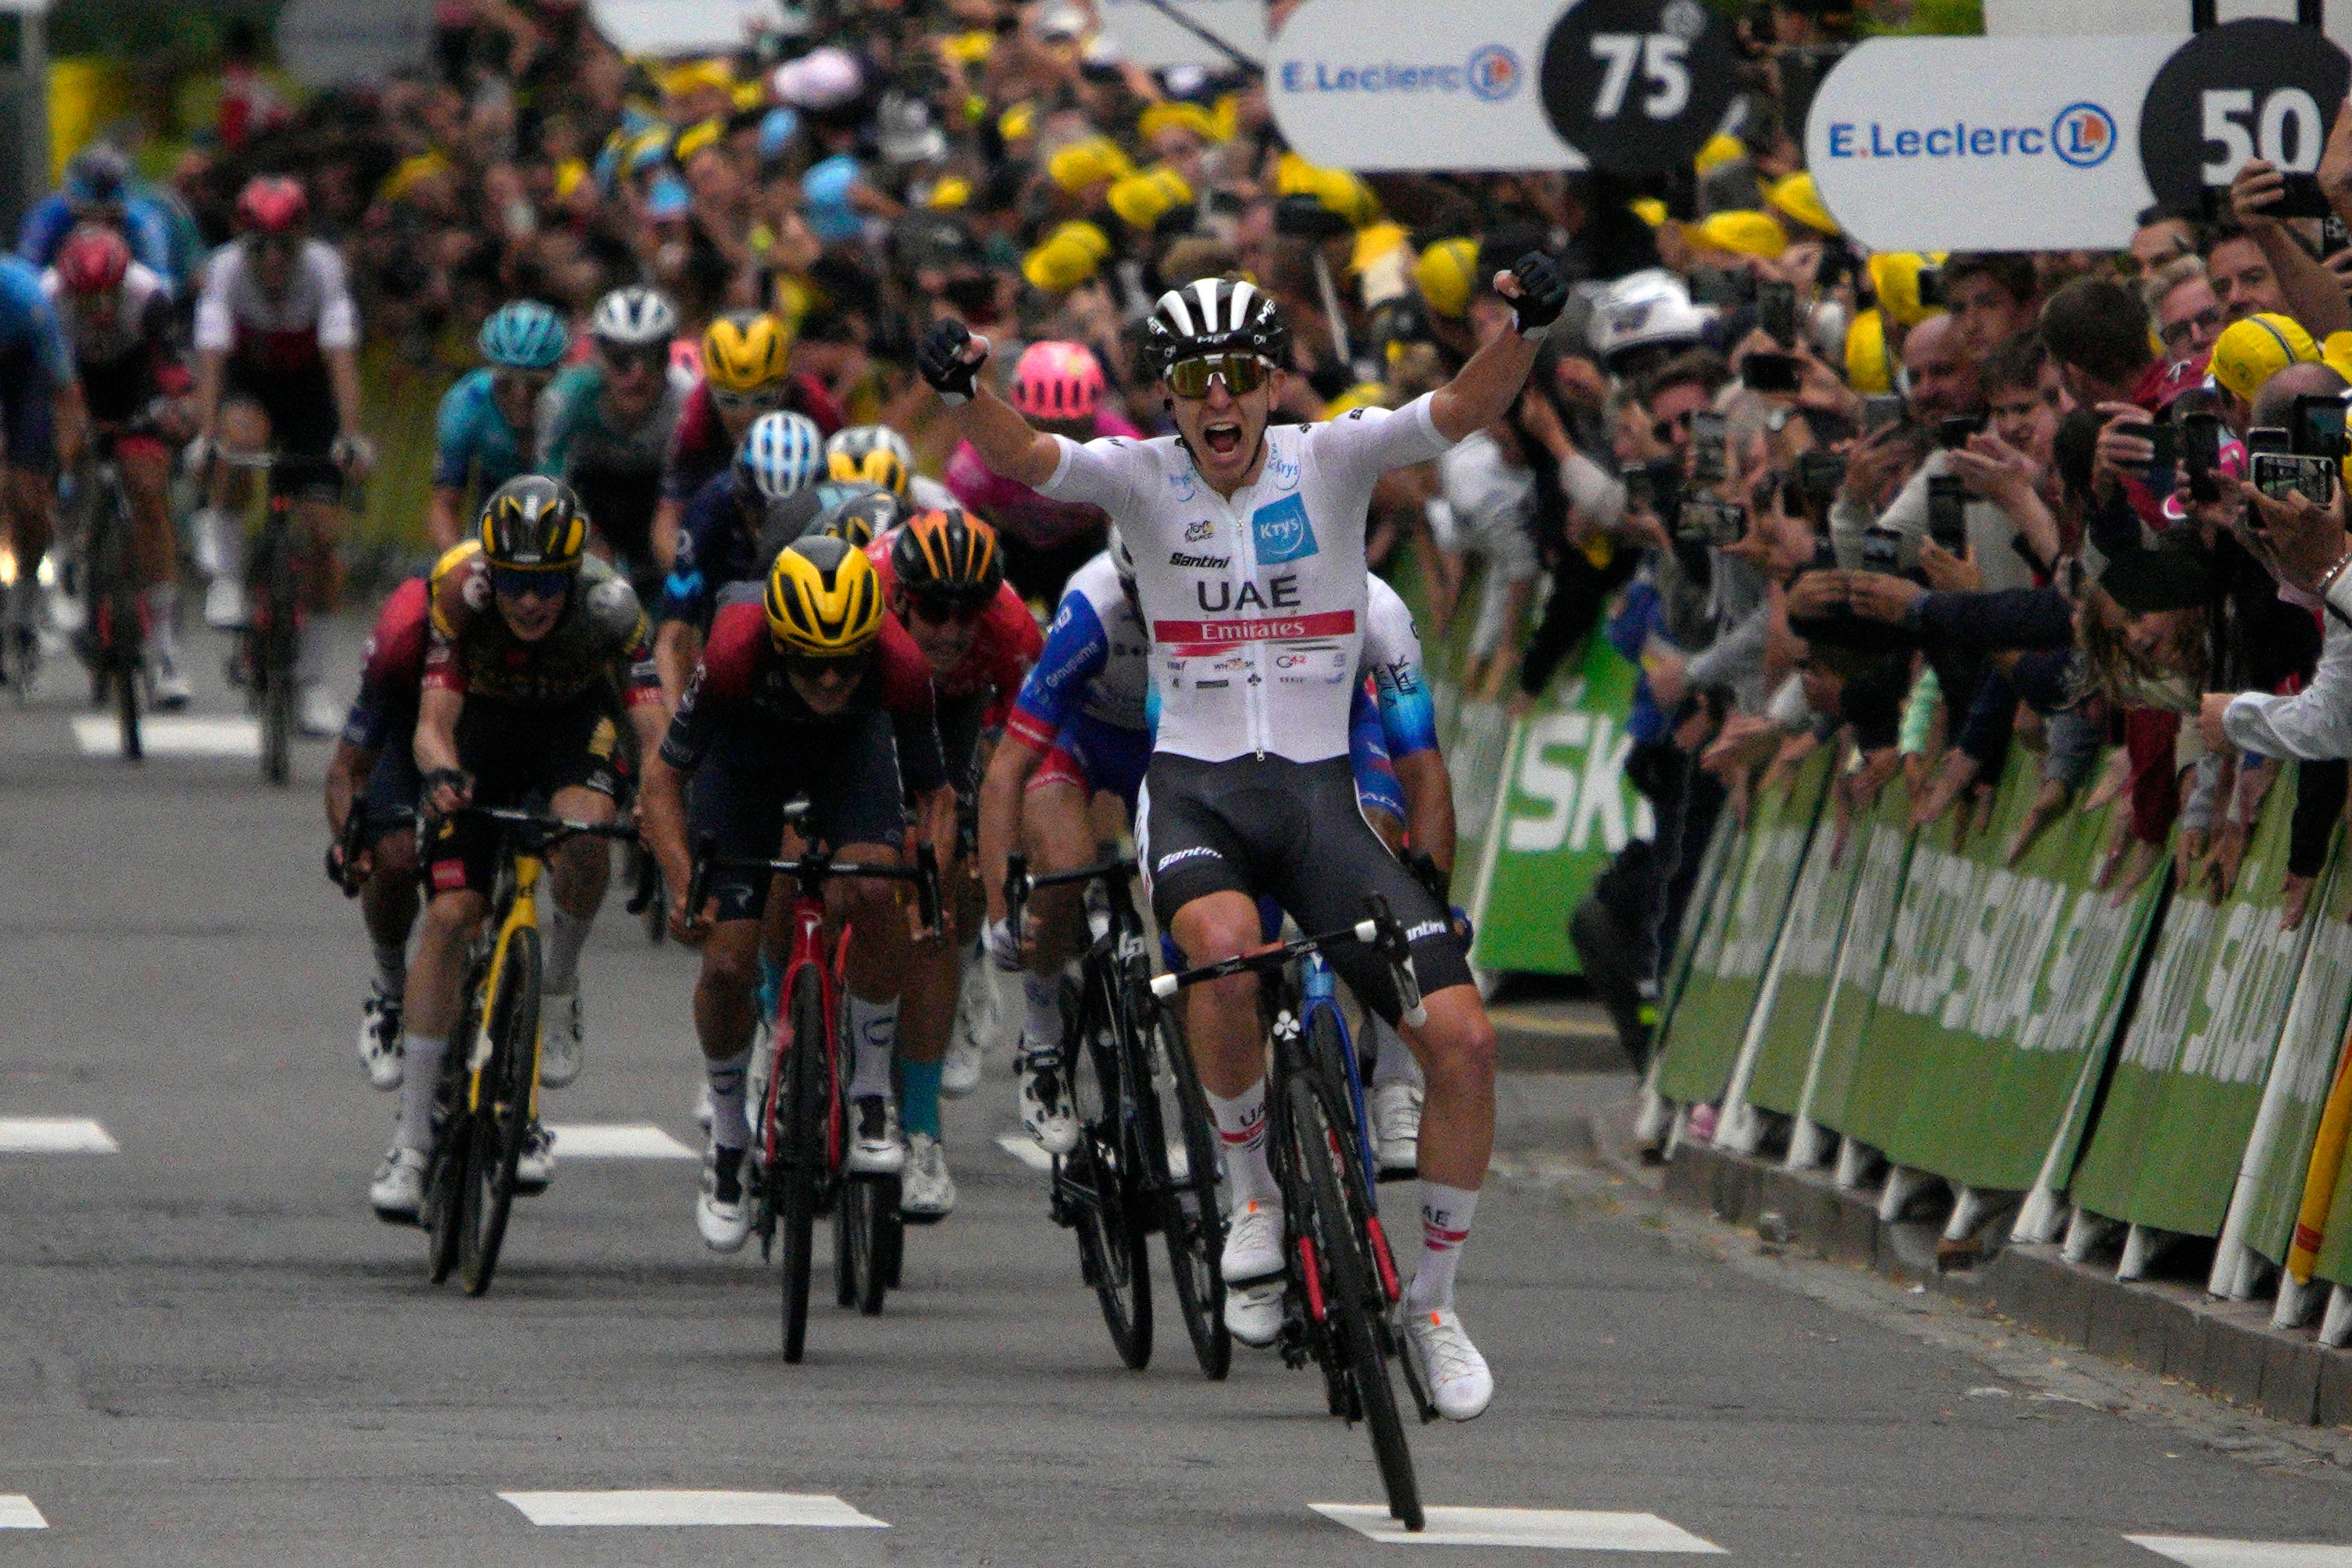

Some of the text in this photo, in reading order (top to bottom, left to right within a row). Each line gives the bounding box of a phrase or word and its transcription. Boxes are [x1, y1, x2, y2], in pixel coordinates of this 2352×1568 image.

[1281, 61, 1462, 93] E.Leclerc
[1590, 34, 1691, 120] 75
[1828, 122, 2045, 158] E.Leclerc
[2201, 87, 2324, 187] 50
[1260, 518, 1300, 542] Krys
[1169, 551, 1231, 569] Santini
[1197, 575, 1302, 612] UAE
[1200, 620, 1305, 641] Emirates
[1157, 845, 1223, 872] Santini
